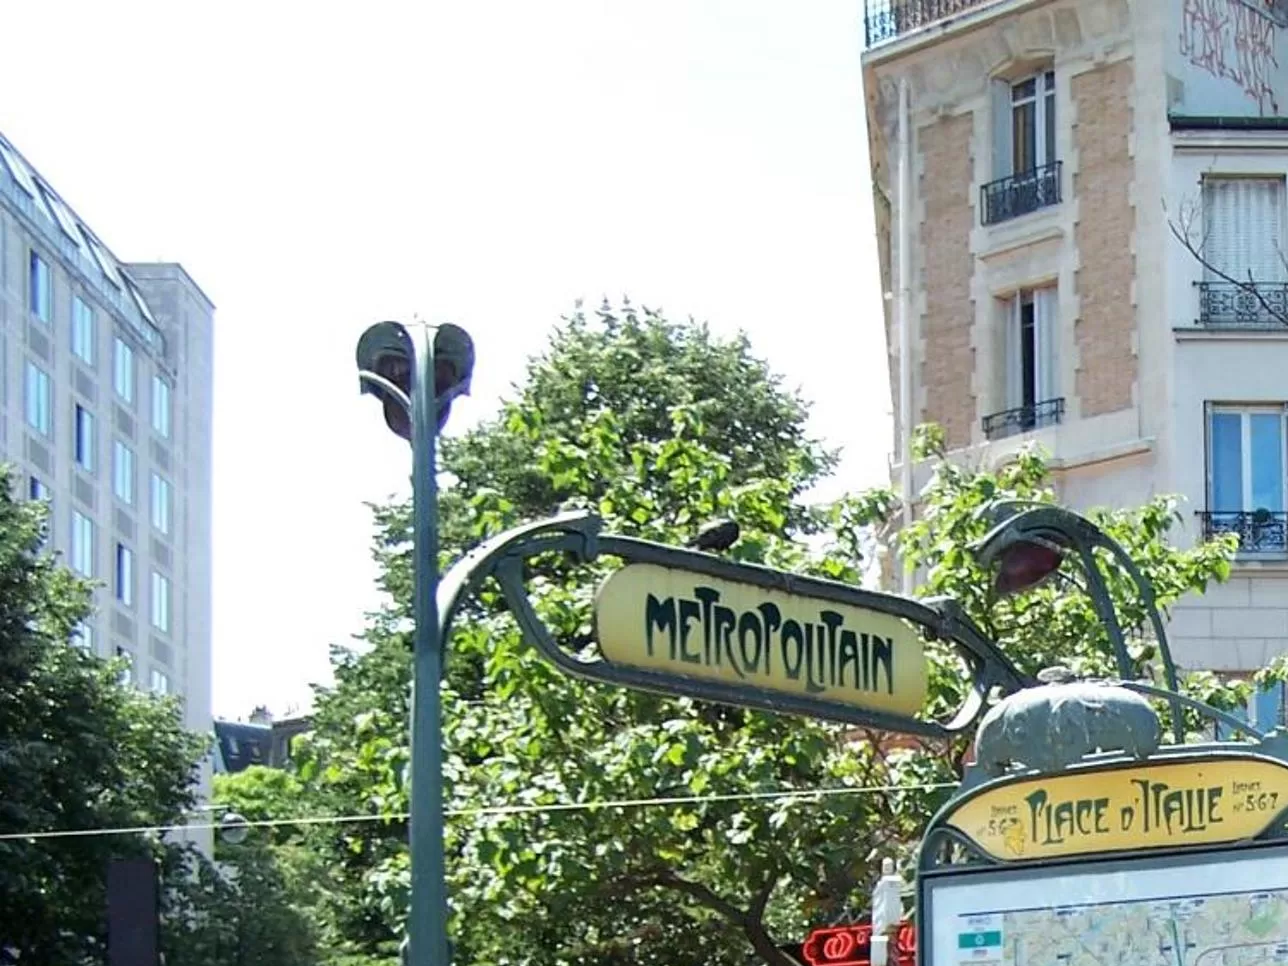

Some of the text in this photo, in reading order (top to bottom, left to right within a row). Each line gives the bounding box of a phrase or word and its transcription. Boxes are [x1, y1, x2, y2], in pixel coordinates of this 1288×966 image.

[645, 585, 894, 695] METROPOLITAIN
[1025, 779, 1224, 845] PLACE D'ITALIE
